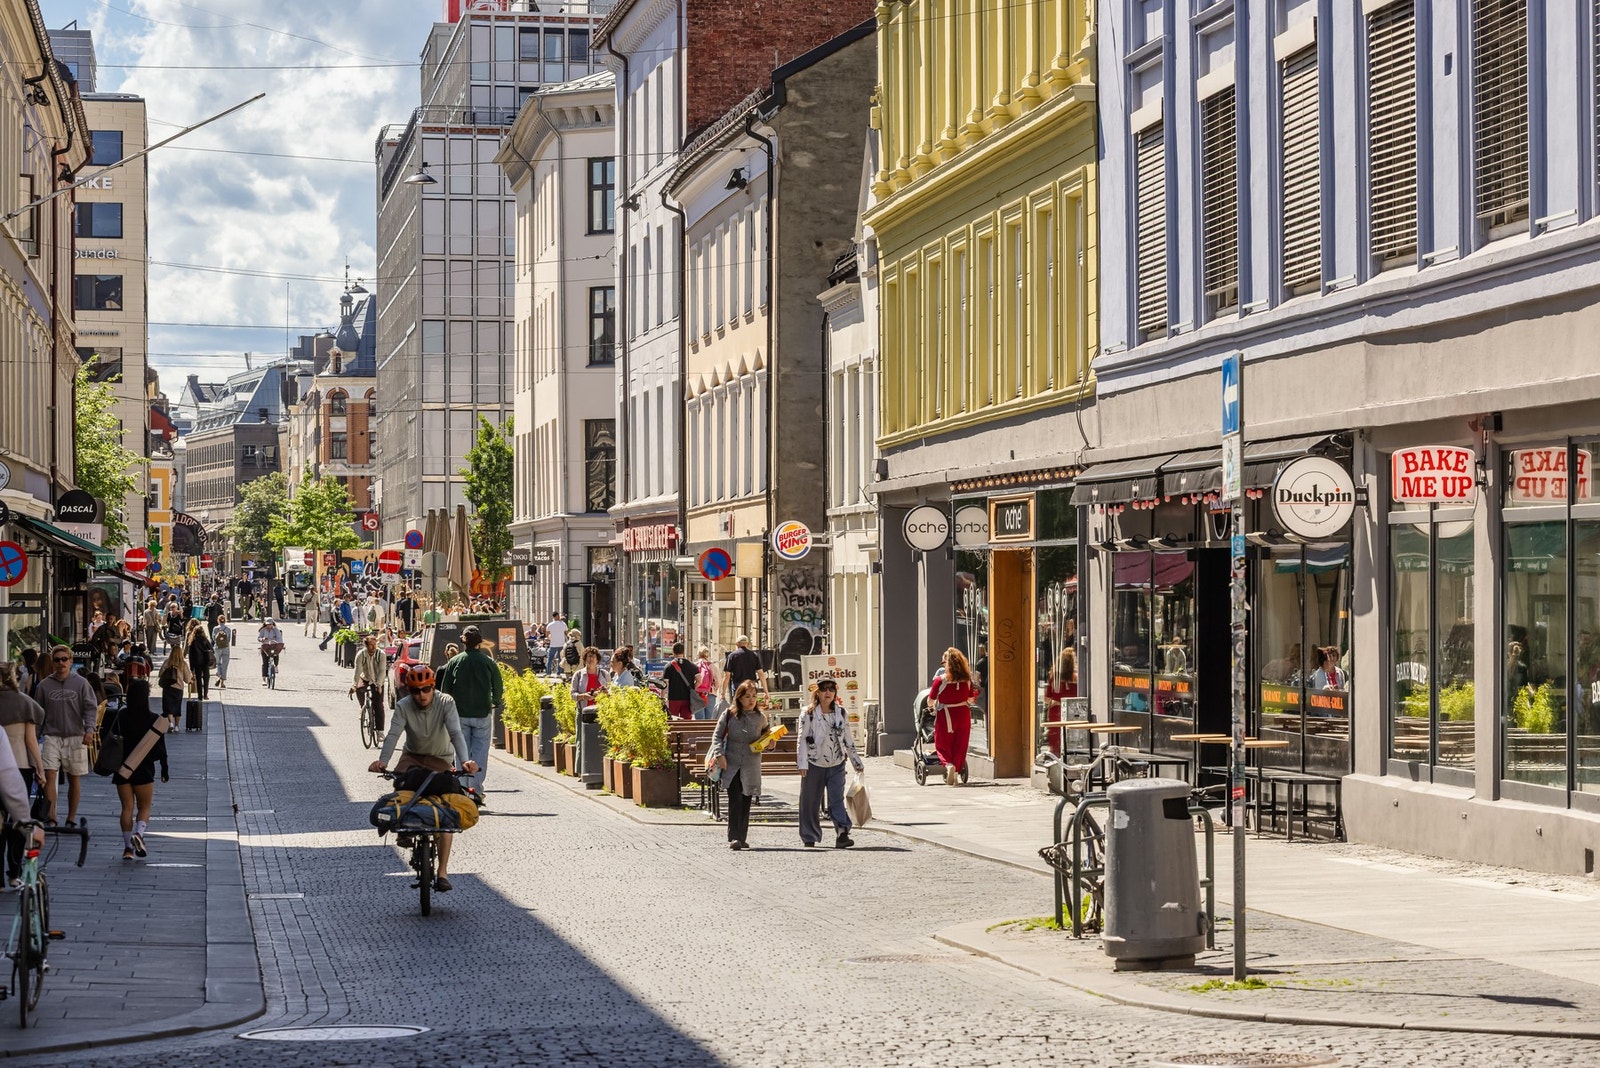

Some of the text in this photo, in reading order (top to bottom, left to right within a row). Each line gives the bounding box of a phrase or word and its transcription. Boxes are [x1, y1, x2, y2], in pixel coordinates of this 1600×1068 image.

[1402, 449, 1469, 473] BAKE
[1402, 477, 1473, 498] ME UP
[1278, 484, 1352, 507] Duckpin
[60, 504, 94, 515] PASCAL
[908, 522, 947, 533] oche
[779, 528, 807, 542] BURGER
[780, 537, 808, 551] KING
[808, 669, 857, 679] Sidekicks
